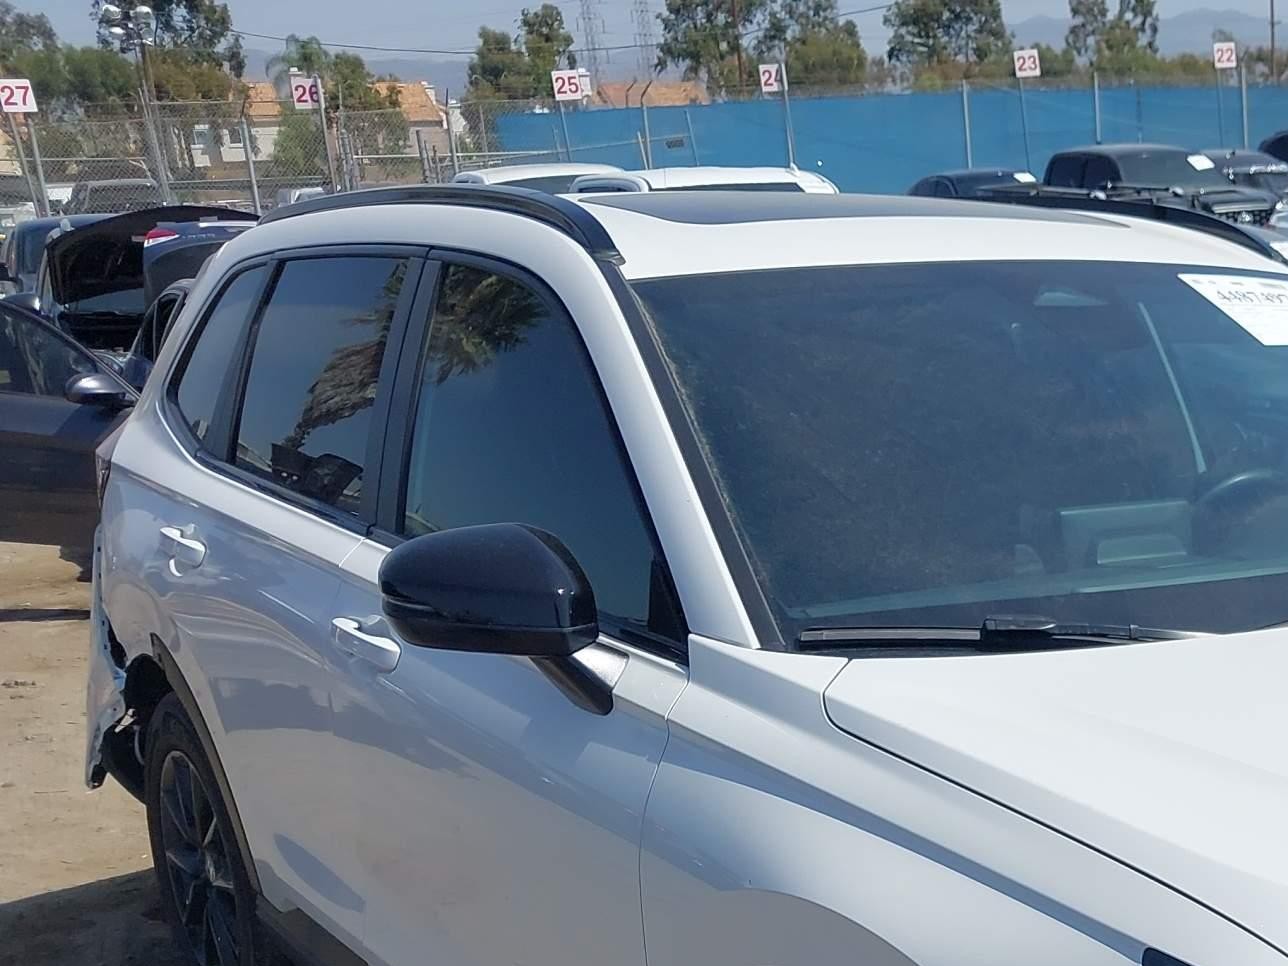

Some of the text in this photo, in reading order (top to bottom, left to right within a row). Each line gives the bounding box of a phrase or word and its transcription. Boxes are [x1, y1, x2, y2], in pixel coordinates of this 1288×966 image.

[1016, 56, 1038, 72] 23
[1216, 48, 1234, 63] 22
[294, 84, 320, 104] 26
[554, 76, 580, 95] 25
[0, 85, 30, 106] 27
